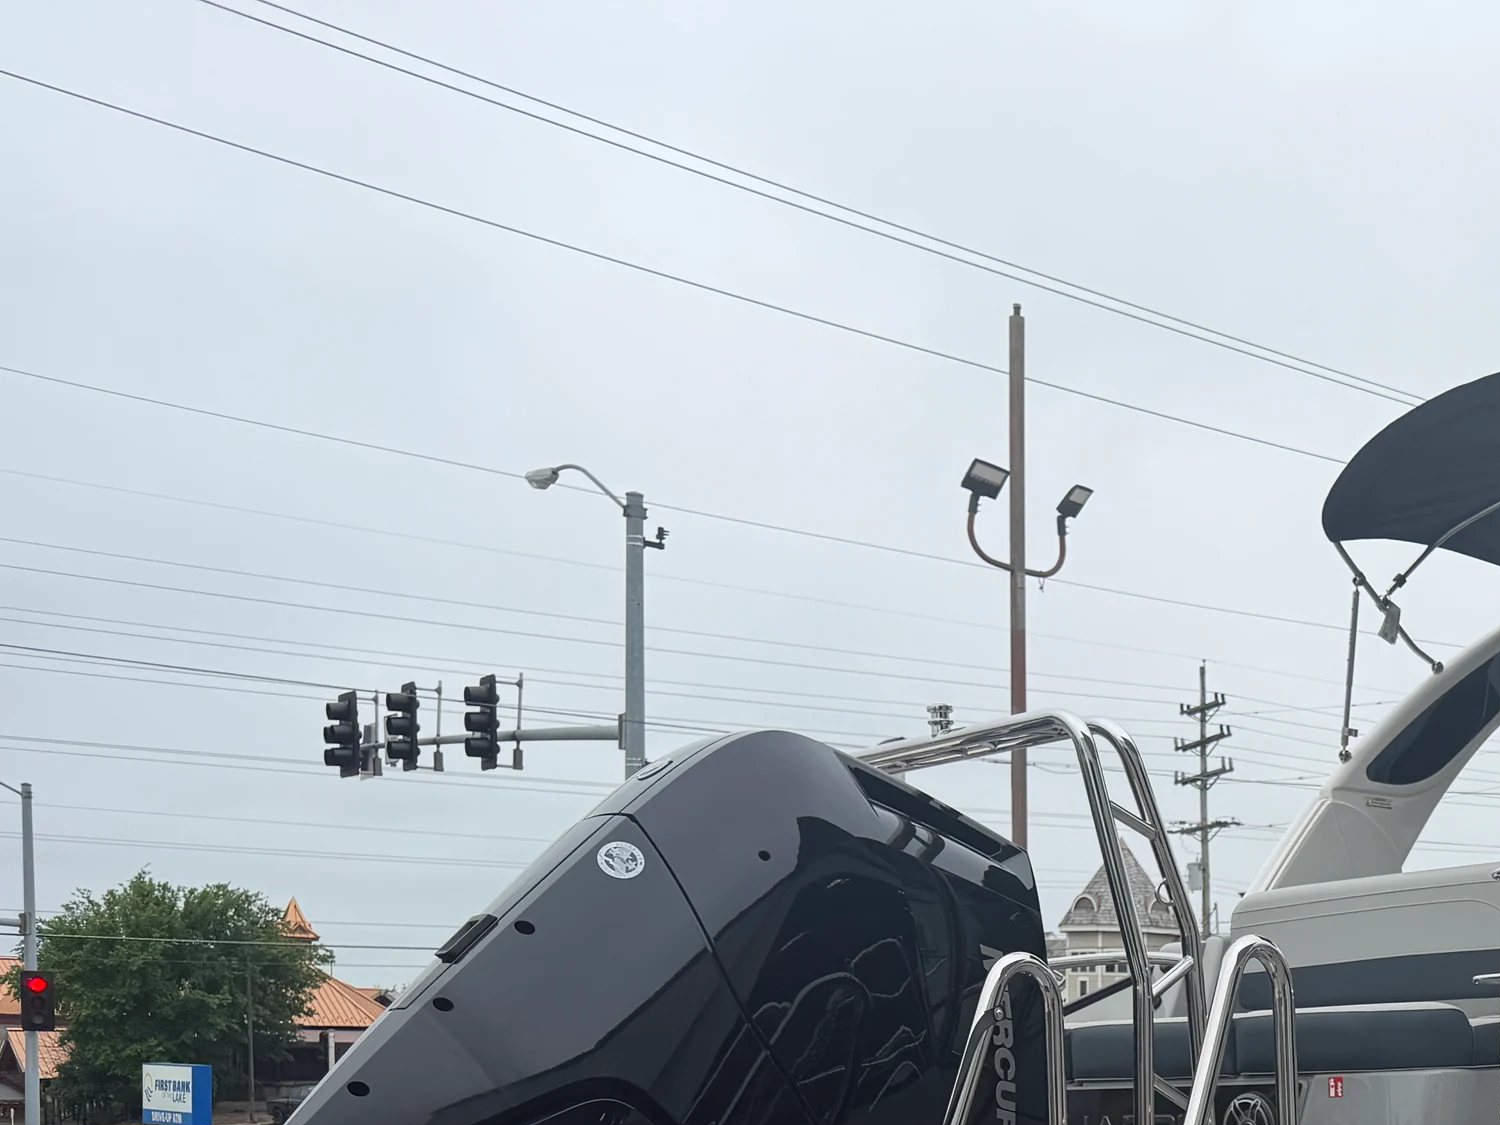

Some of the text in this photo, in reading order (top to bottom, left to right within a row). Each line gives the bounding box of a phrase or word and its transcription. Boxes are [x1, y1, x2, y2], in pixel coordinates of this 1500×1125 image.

[154, 1079, 191, 1093] FIRST BANK
[172, 1093, 186, 1104] LAKE
